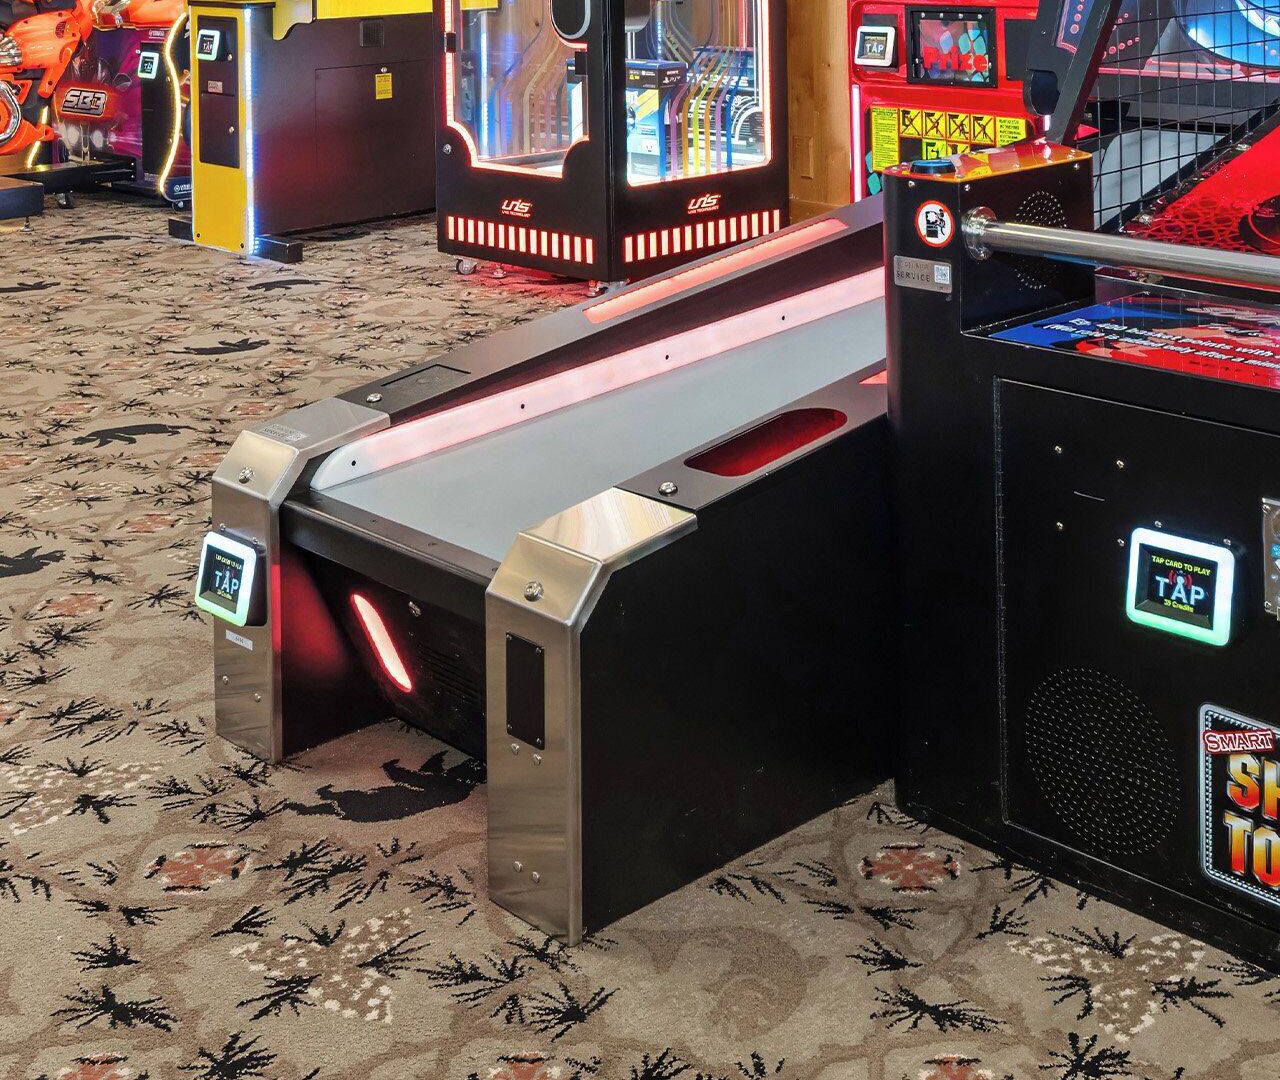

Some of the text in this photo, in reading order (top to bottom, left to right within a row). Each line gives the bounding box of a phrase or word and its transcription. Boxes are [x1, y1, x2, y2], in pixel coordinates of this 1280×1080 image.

[865, 43, 884, 53] TAP
[922, 45, 988, 72] Prize
[1179, 336, 1234, 350] points
[1235, 346, 1274, 358] with
[1194, 349, 1234, 361] after
[1152, 555, 1165, 564] TAP
[1165, 558, 1183, 569] CARD
[1183, 563, 1193, 571] TO
[214, 570, 239, 594] TAP
[1155, 575, 1205, 606] TAP
[1204, 730, 1274, 752] SMART
